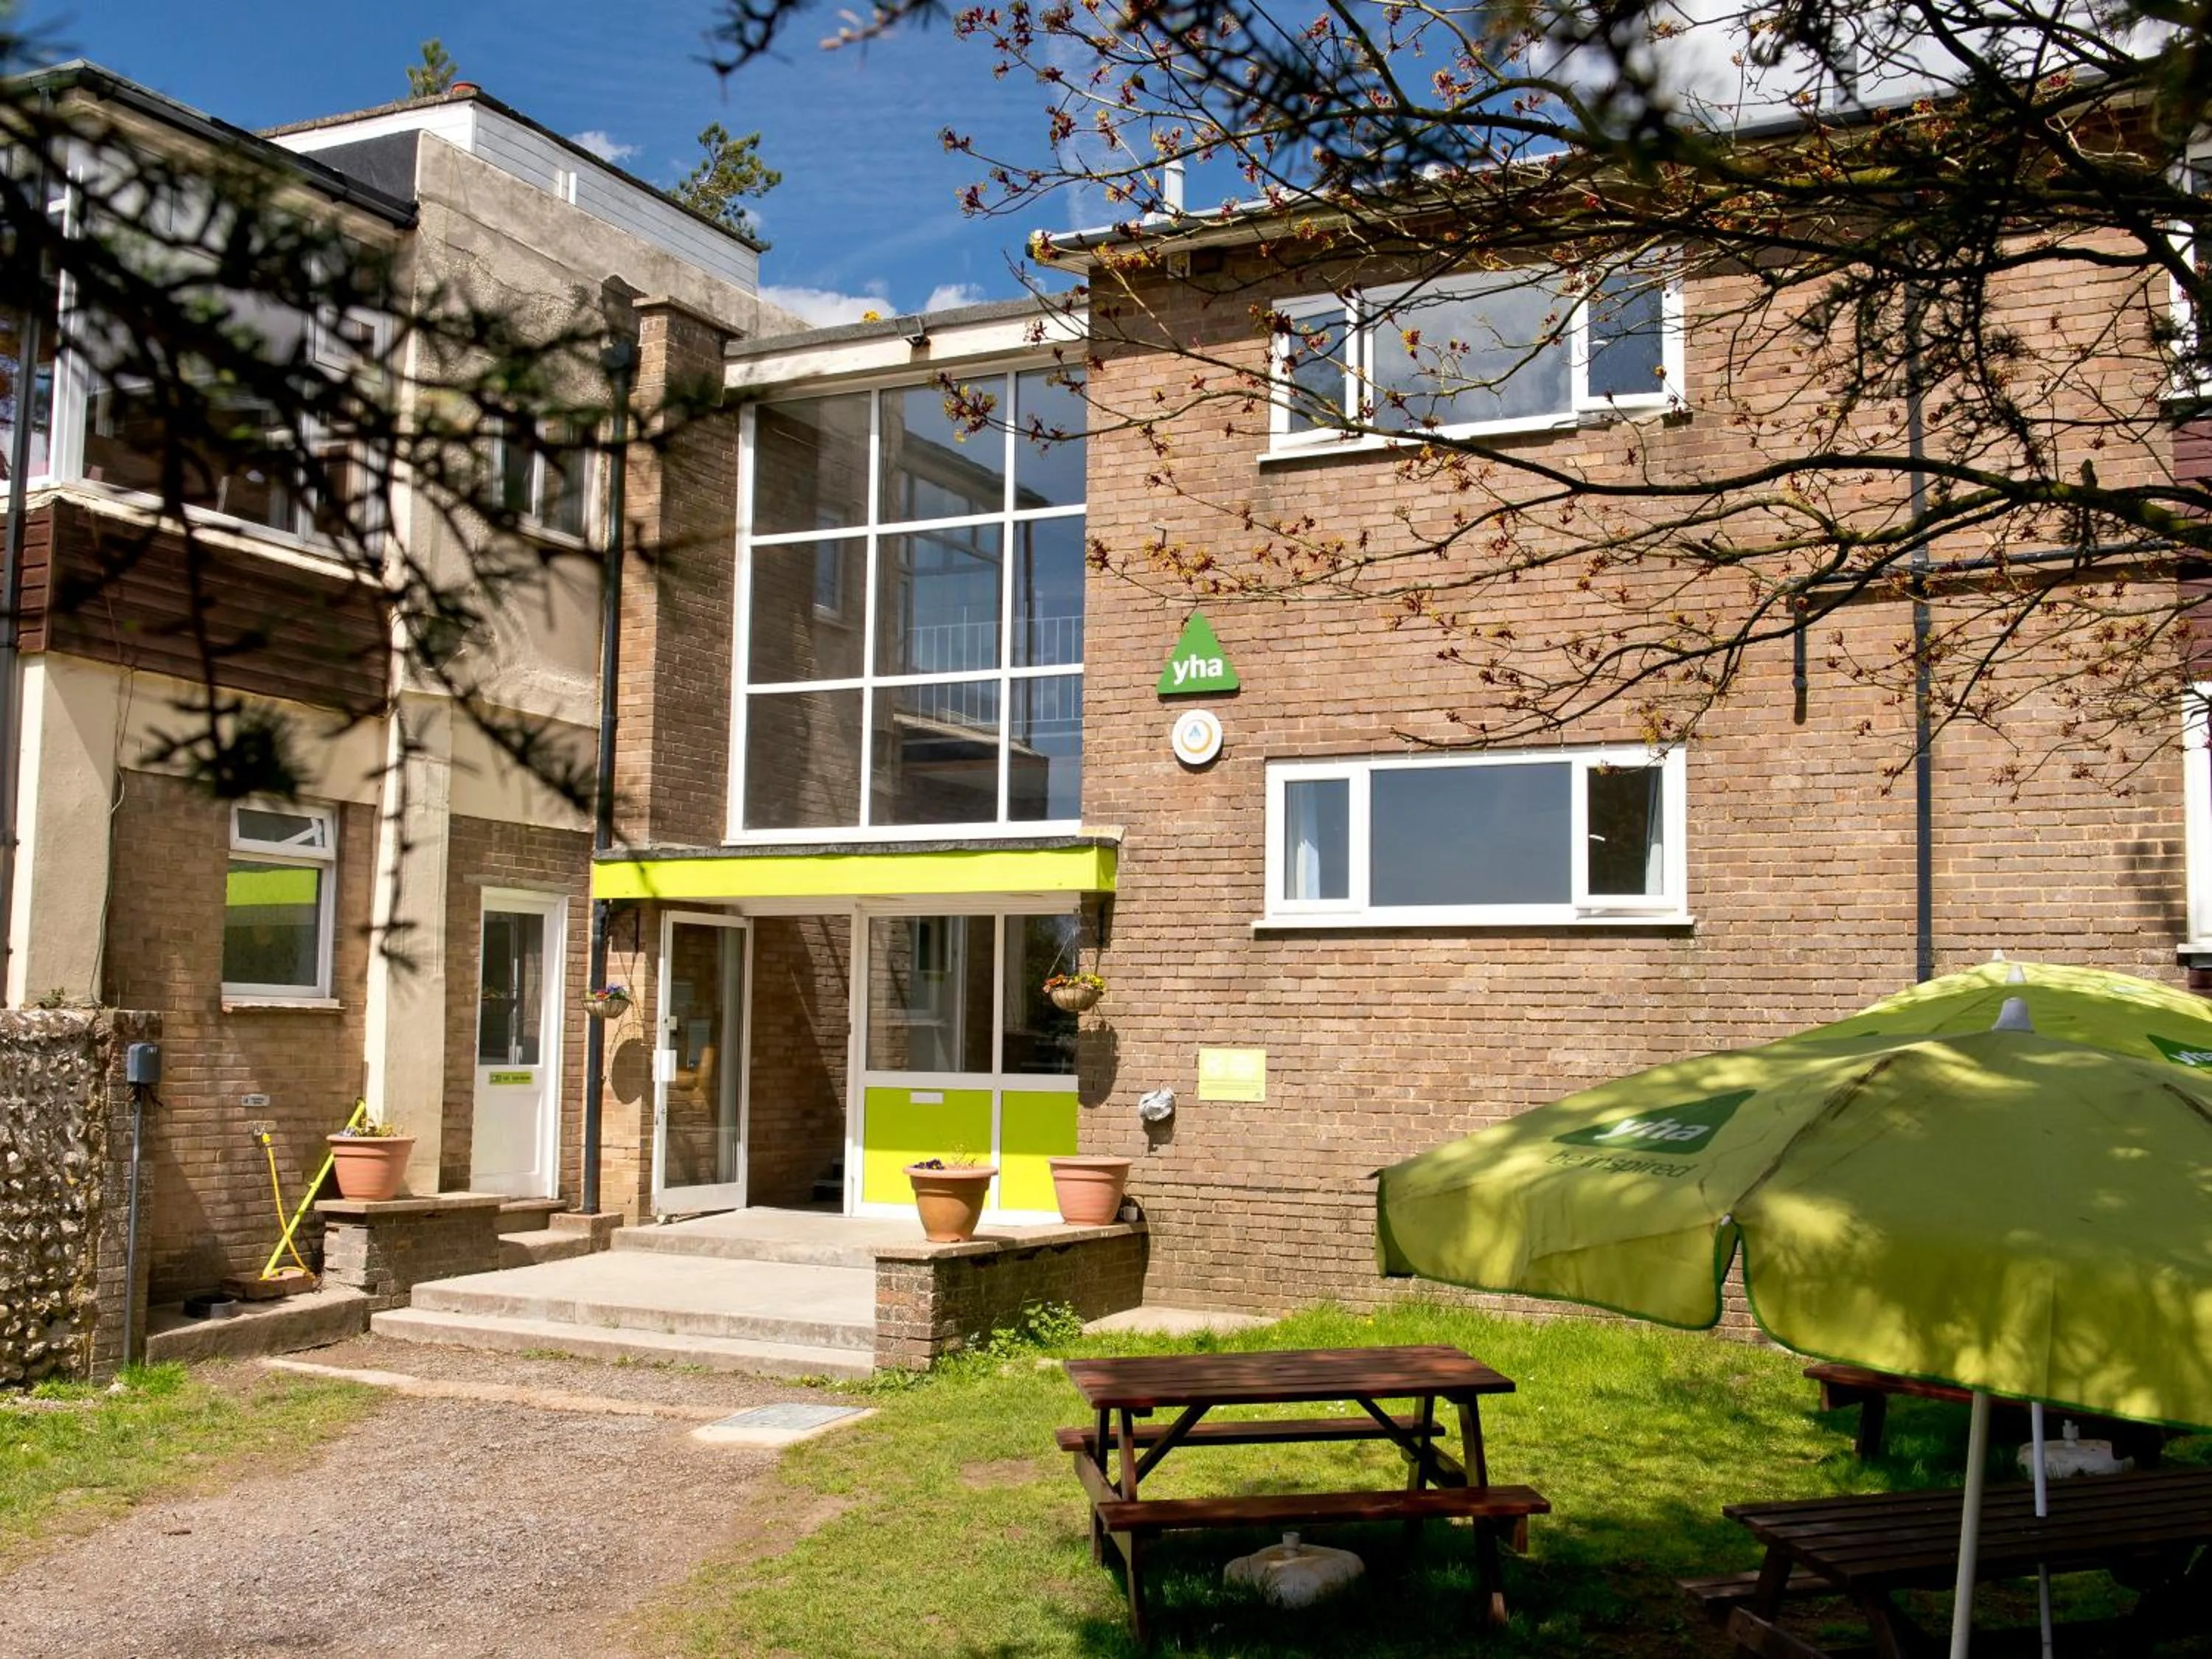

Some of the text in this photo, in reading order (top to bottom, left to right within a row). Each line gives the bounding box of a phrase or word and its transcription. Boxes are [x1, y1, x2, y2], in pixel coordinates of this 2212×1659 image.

[1172, 653, 1223, 686] yha
[1593, 1119, 1710, 1141] yha
[1581, 1155, 1698, 1178] inspired
